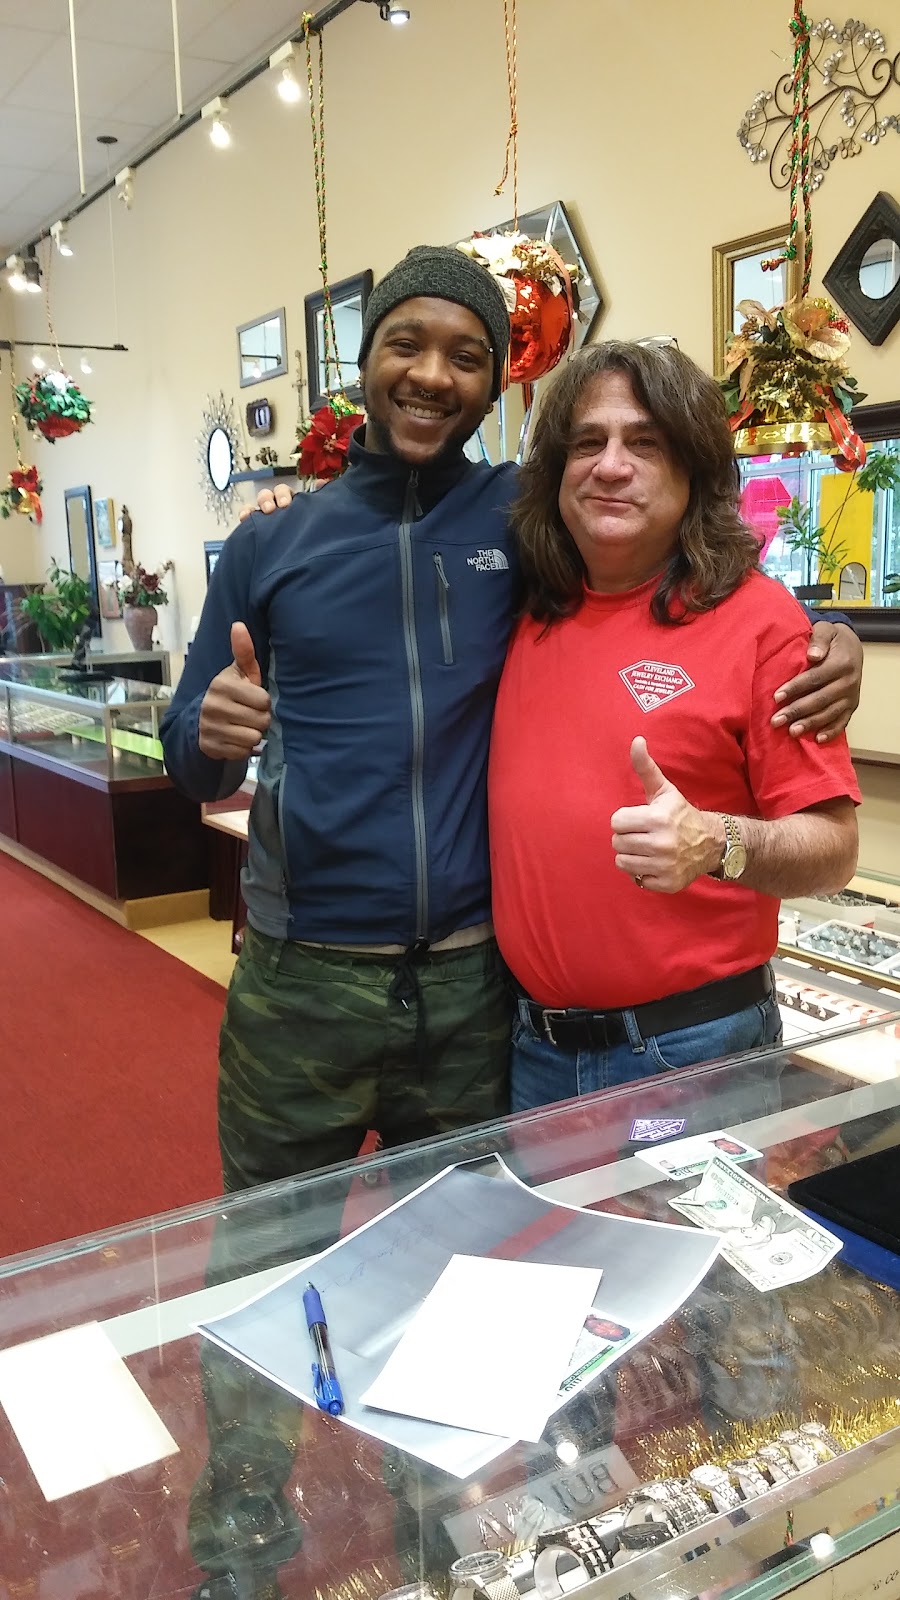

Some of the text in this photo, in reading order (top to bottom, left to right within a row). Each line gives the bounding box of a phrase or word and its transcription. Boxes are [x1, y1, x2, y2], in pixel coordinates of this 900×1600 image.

[477, 549, 494, 557] THE
[467, 556, 494, 566] NORTH
[475, 563, 497, 571] FACE
[644, 665, 676, 676] CLEVELAND
[630, 670, 654, 680] JEWELRY
[654, 674, 684, 685] EXCHANGE
[633, 683, 646, 691] CASH
[654, 687, 675, 695] JEWELRY
